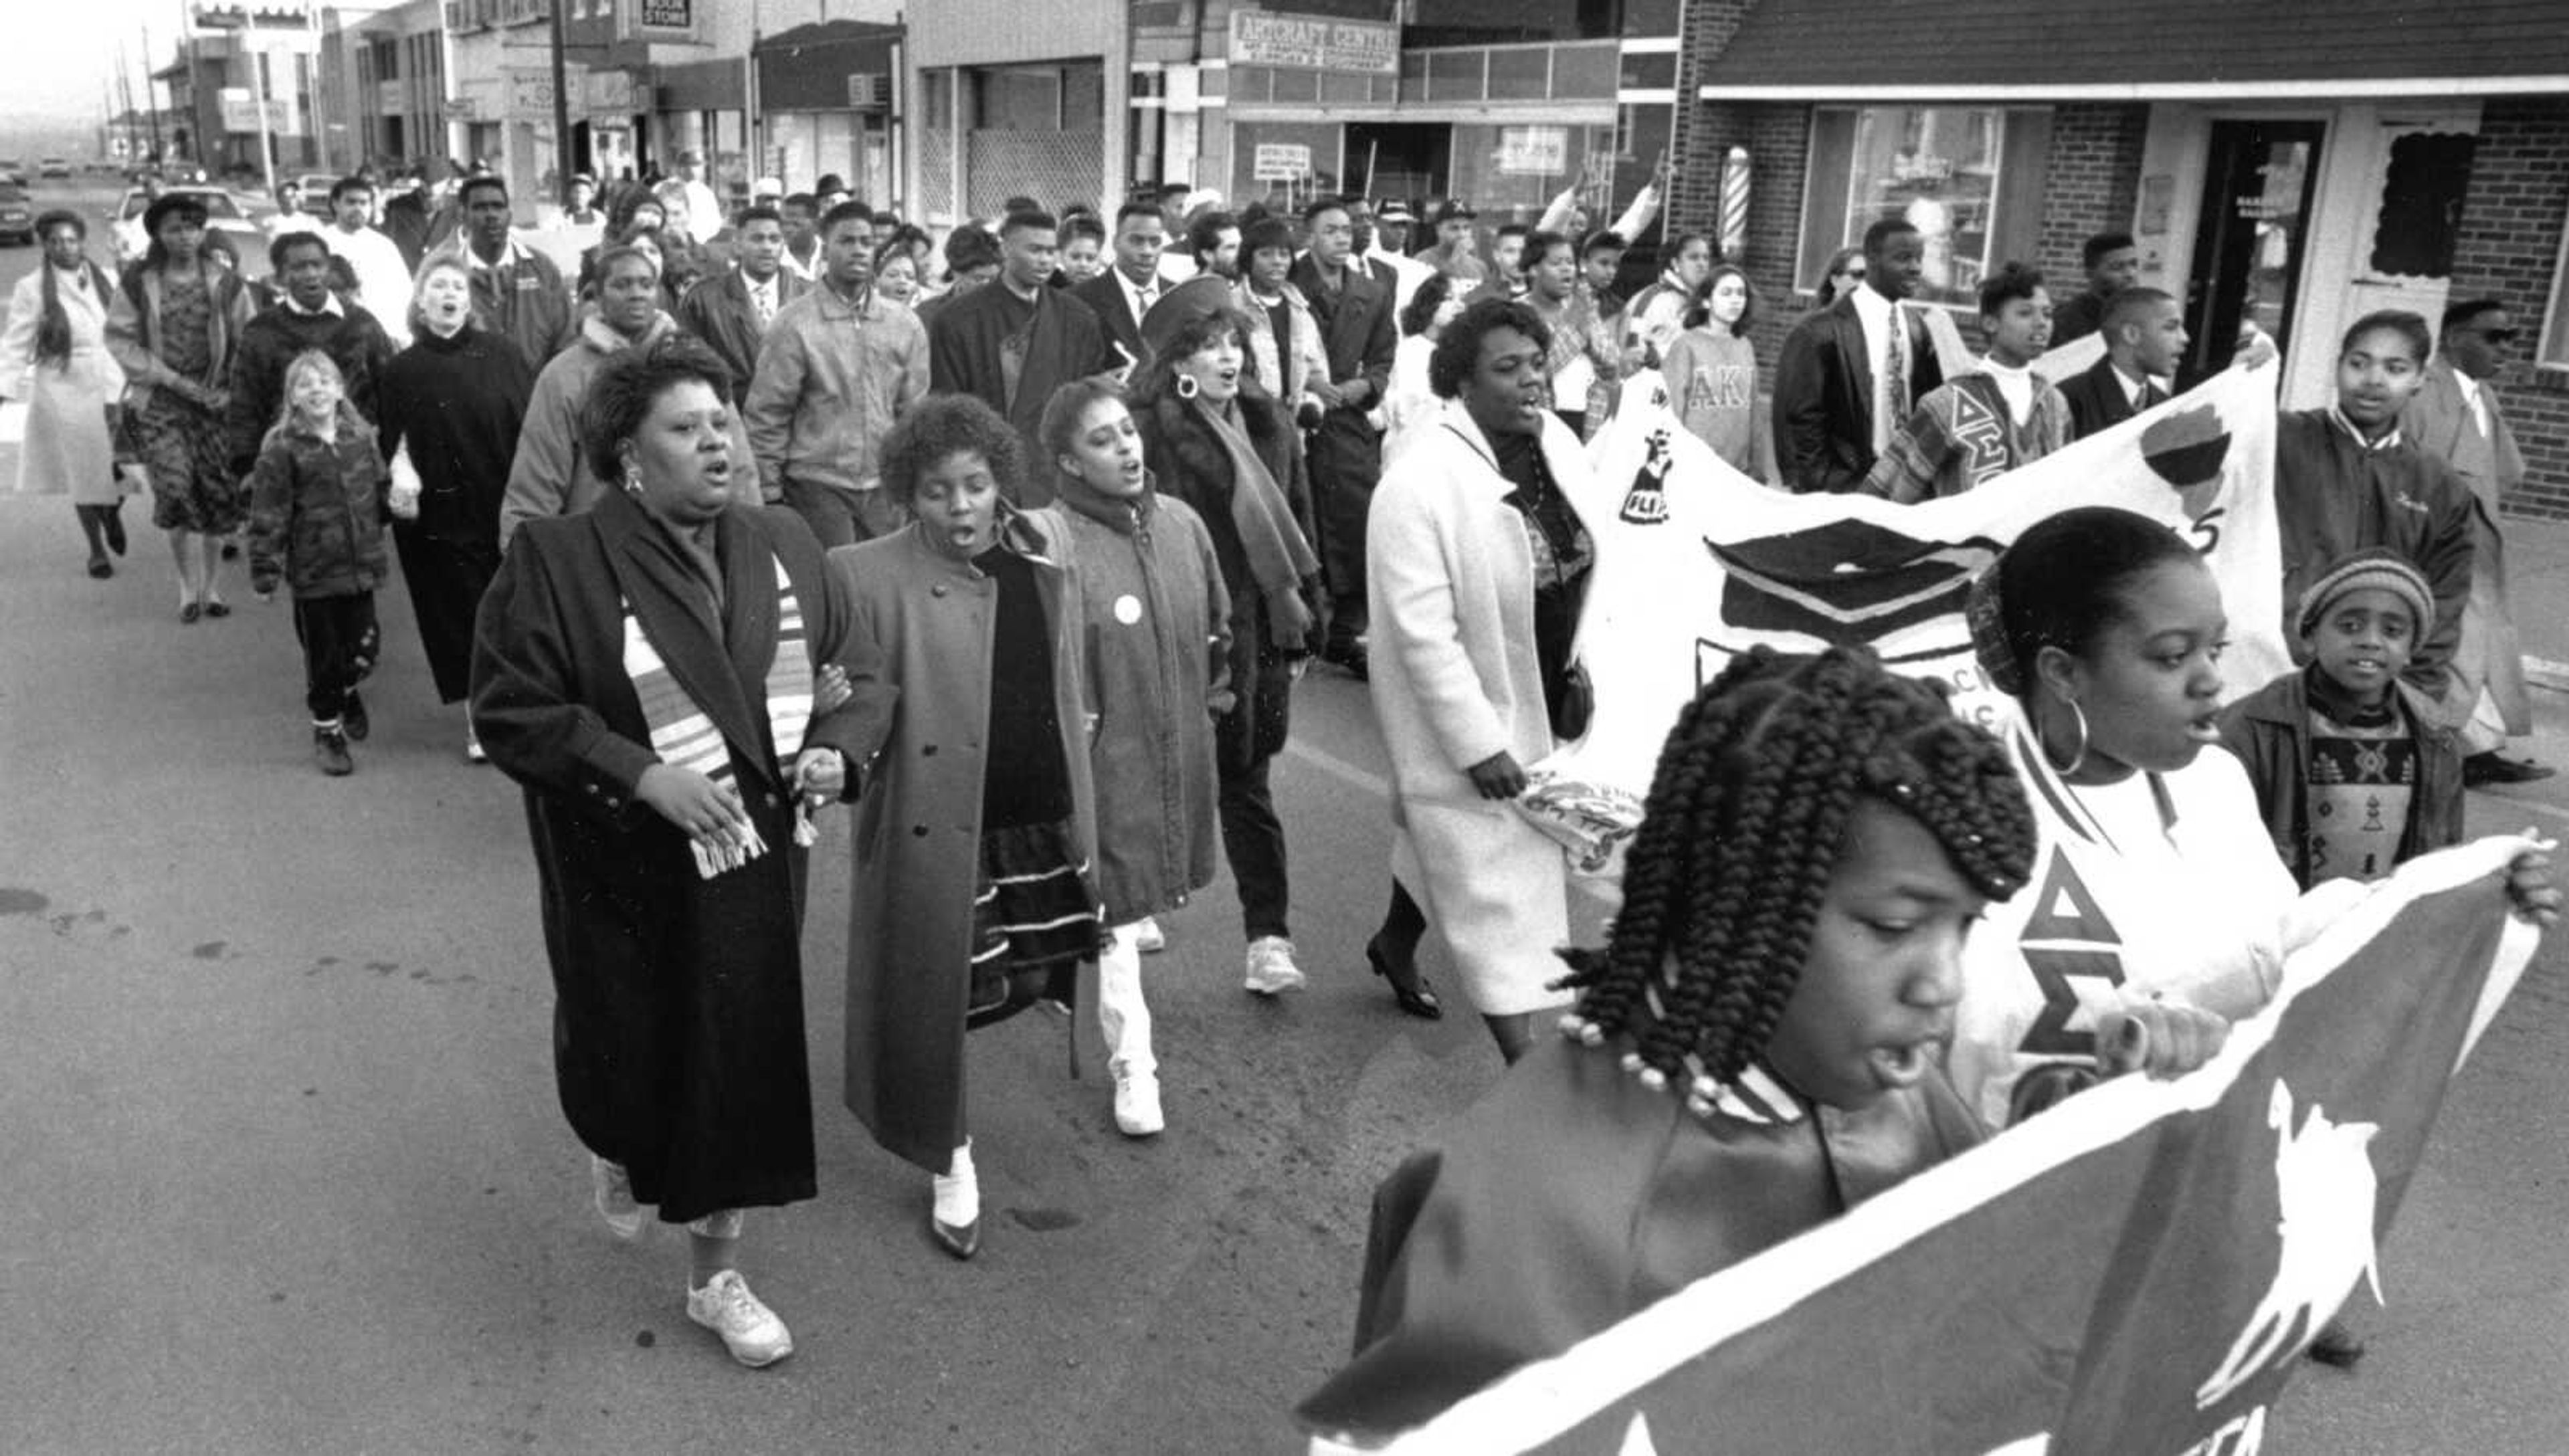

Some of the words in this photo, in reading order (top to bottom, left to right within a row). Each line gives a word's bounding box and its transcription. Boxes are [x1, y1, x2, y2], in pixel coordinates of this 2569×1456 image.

[645, 11, 686, 24] STORE
[1242, 17, 1328, 47] ARTCRAFT
[1952, 385, 2006, 486] ΔΣ
